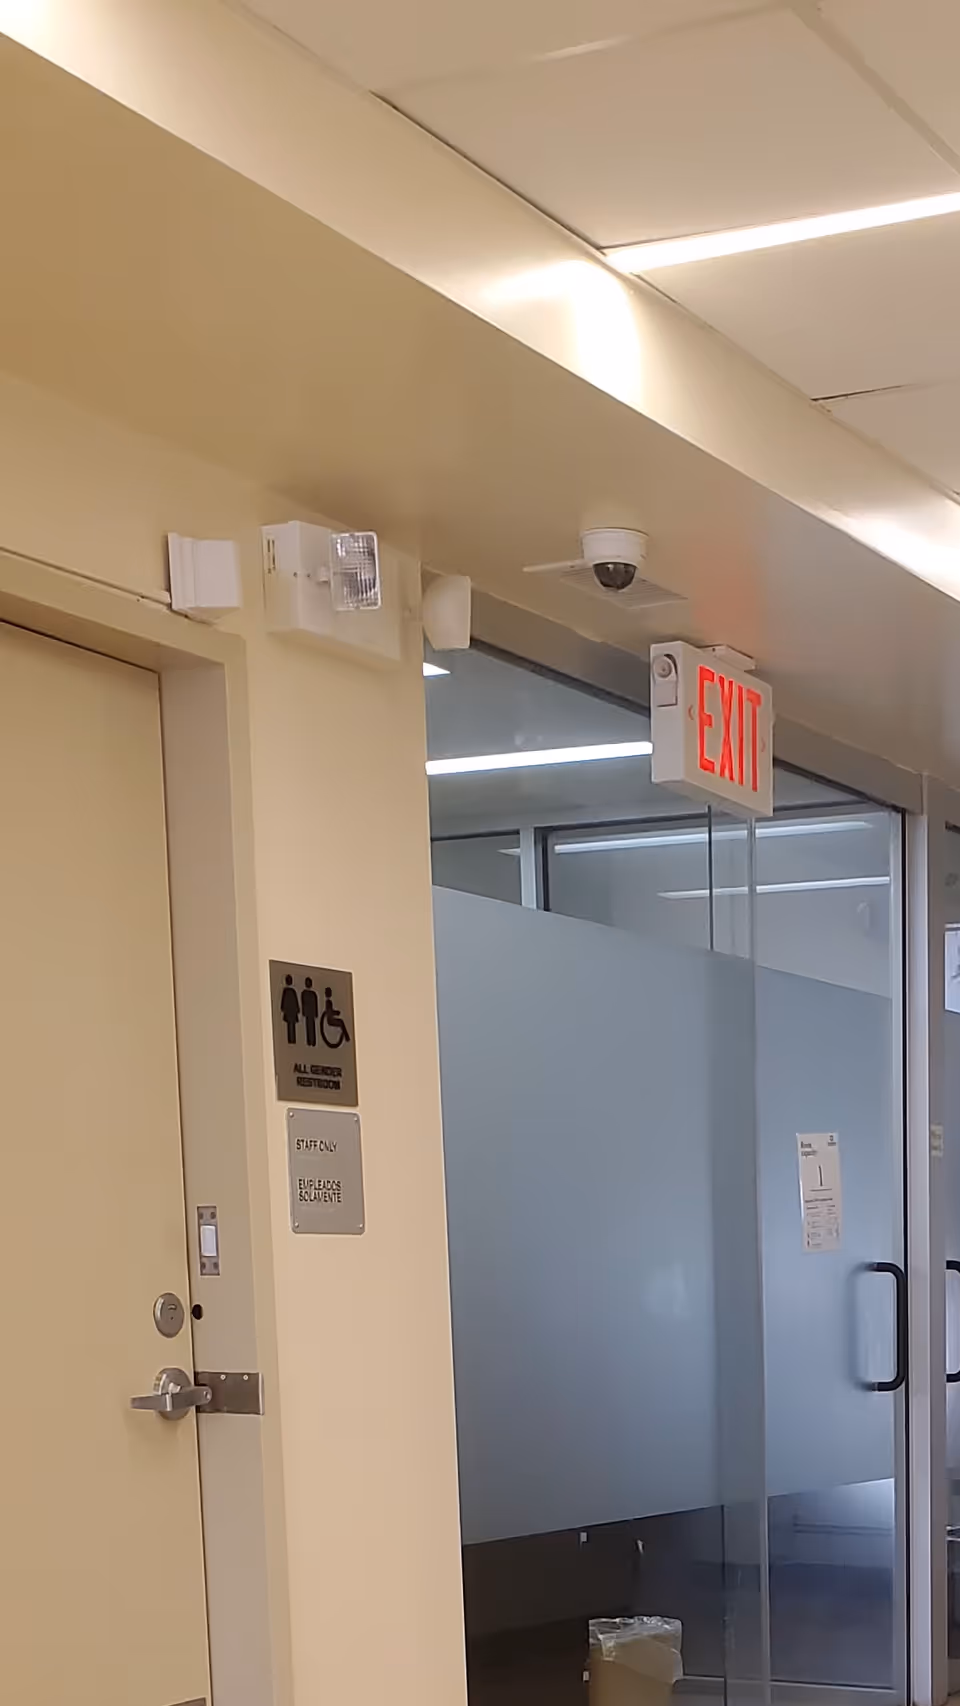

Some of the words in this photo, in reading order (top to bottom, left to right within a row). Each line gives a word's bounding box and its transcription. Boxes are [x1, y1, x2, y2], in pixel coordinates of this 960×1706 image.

[697, 664, 761, 792] EXIT
[293, 1063, 309, 1075] ALL
[296, 1139, 318, 1151] STAFF
[299, 1190, 342, 1203] SOLAMENTE
